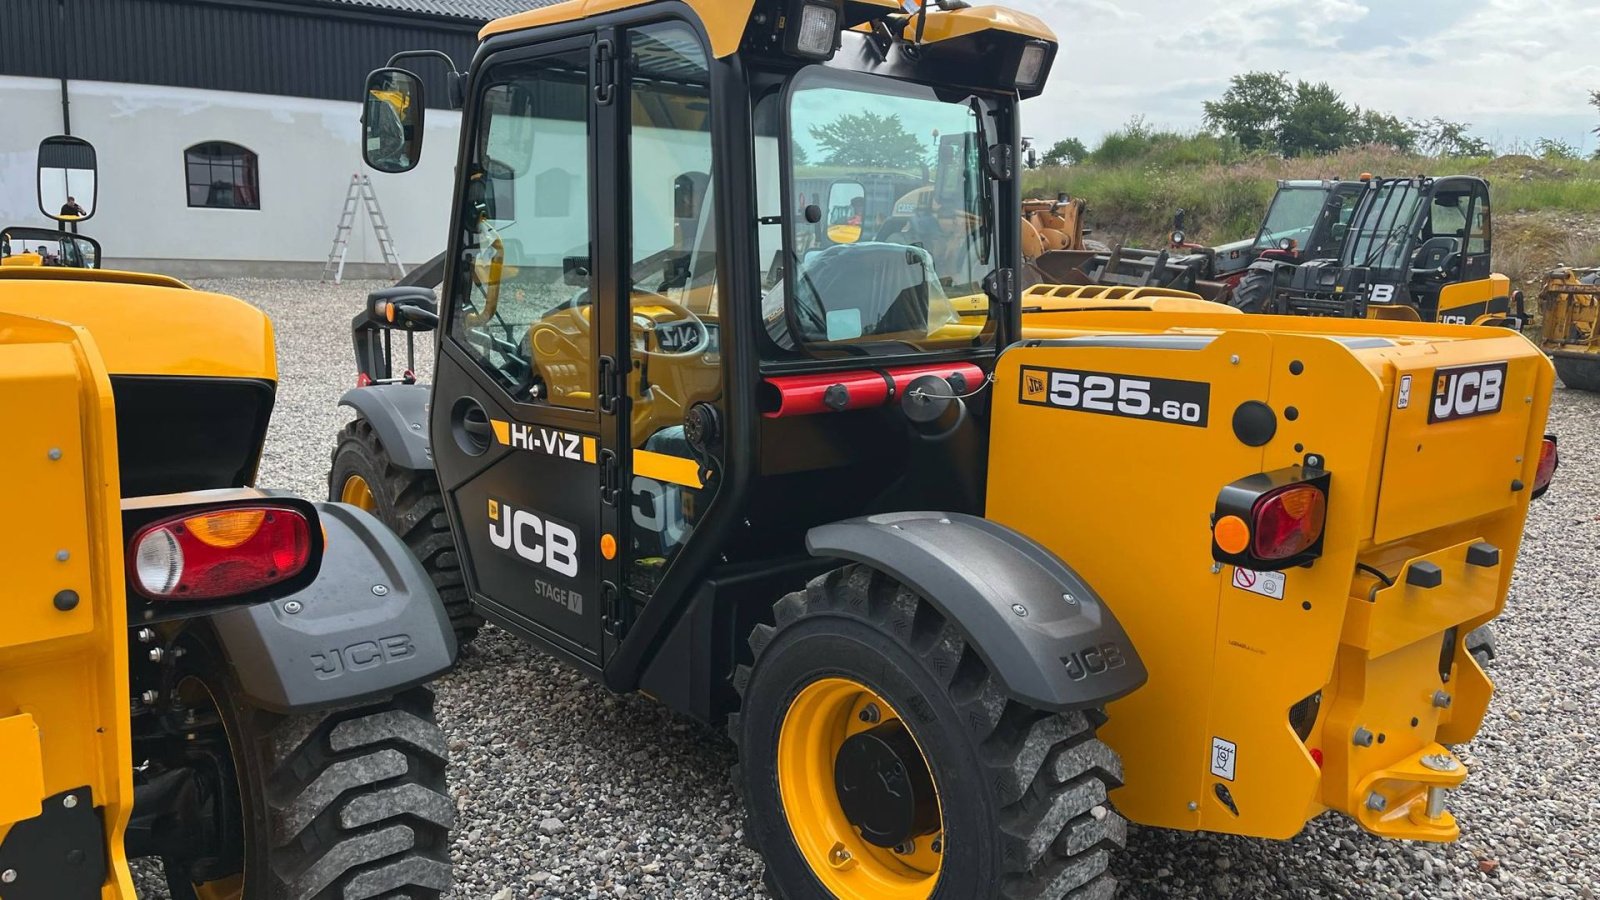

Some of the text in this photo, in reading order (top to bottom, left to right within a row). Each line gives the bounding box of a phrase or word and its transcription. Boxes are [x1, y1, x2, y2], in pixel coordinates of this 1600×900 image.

[1028, 377, 1044, 393] JCB
[1050, 372, 1200, 422] 525-60
[1434, 369, 1503, 419] JCB
[489, 504, 578, 578] JCB
[534, 579, 567, 606] STAGE
[310, 633, 417, 681] JCB
[1059, 642, 1126, 682] JCB
